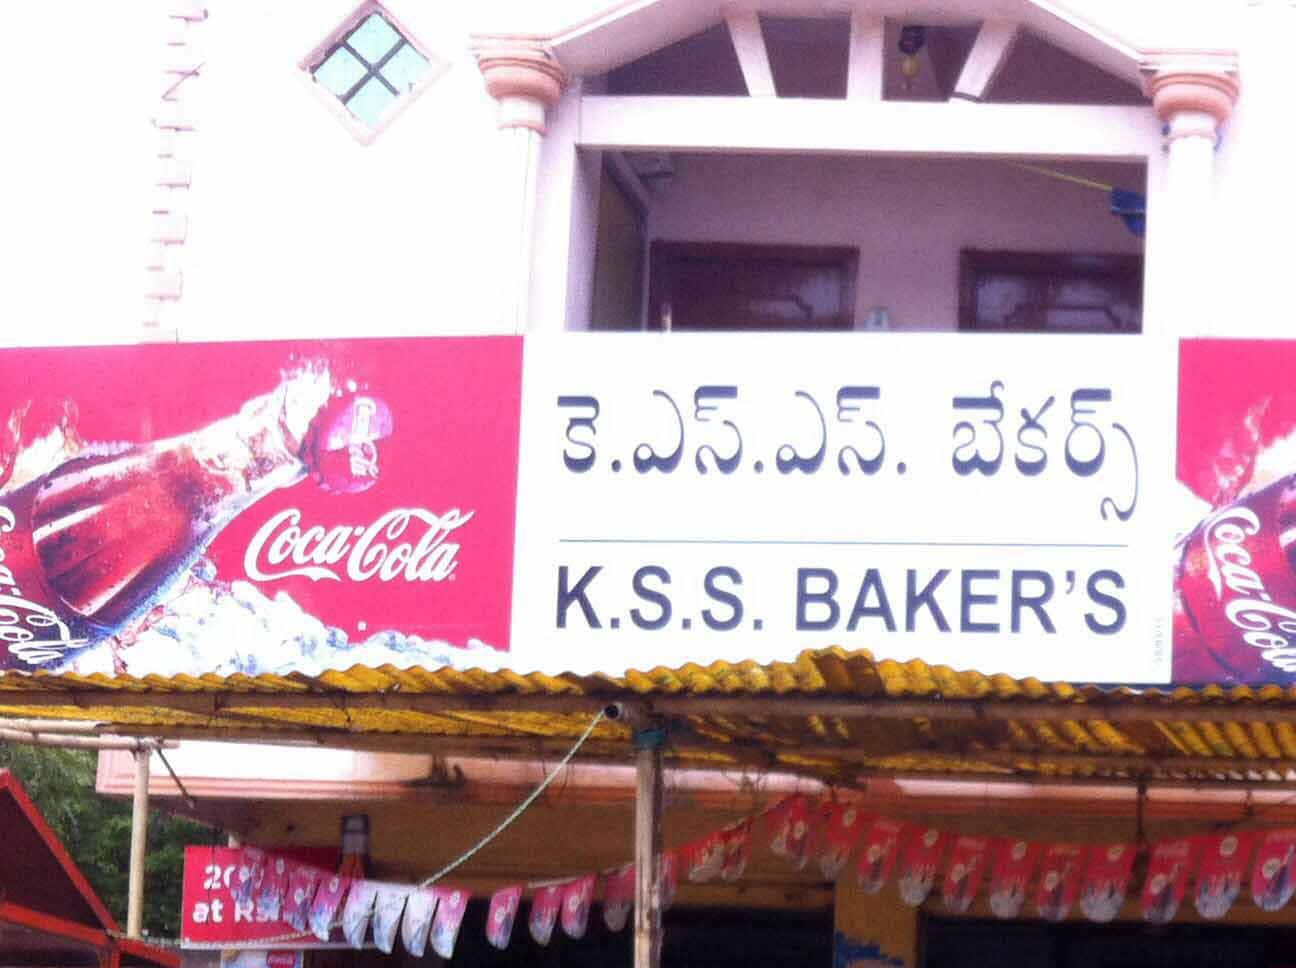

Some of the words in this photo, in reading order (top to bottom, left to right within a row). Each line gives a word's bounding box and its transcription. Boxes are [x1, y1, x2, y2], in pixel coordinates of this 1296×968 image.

[243, 508, 476, 583] Coca-Cola
[555, 564, 764, 632] K.S.S.
[794, 568, 1128, 636] BAKER'S
[193, 899, 224, 924] at
